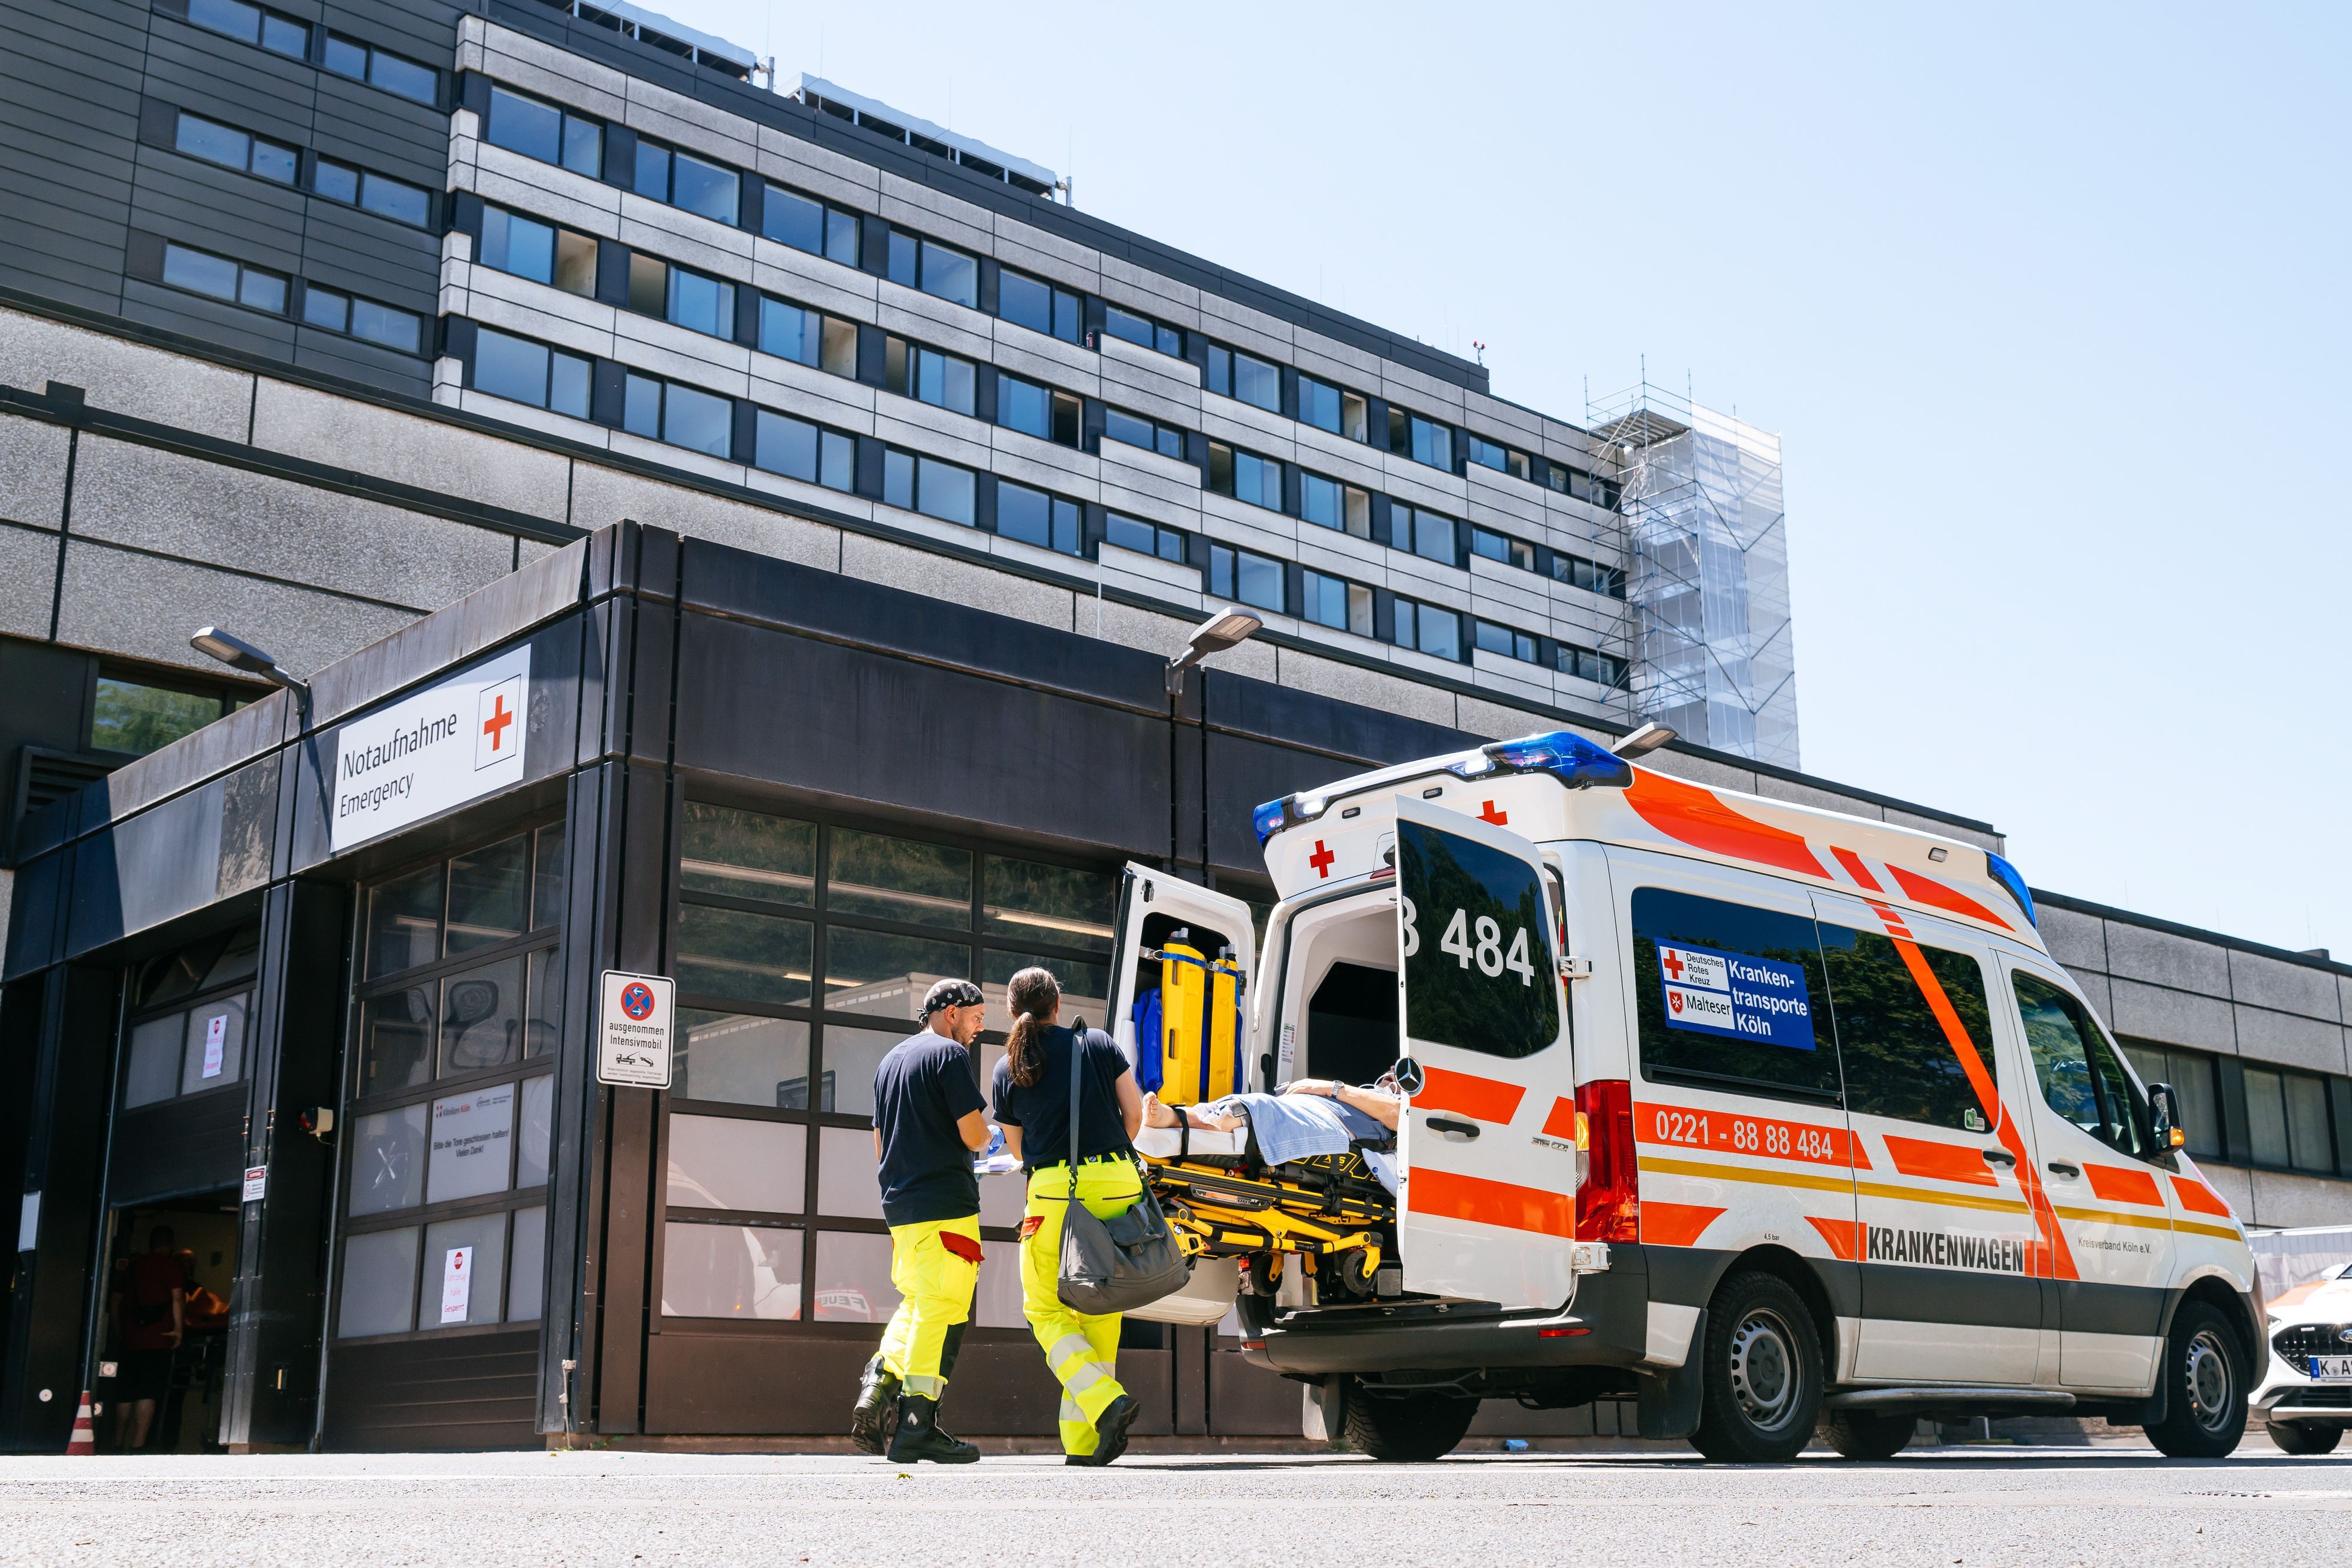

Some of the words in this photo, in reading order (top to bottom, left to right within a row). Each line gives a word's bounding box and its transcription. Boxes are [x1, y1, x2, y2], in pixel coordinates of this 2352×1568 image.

[343, 714, 457, 781] Notaufnahme
[340, 773, 414, 818] Emergency
[1441, 908, 1535, 987] 484
[1686, 952, 1723, 968] Deutsches
[1688, 964, 1709, 975] Rotes
[1689, 974, 1710, 985] Kreuz
[1728, 959, 1795, 988] Kranken-
[1686, 994, 1730, 1015] Malteser
[1732, 987, 1808, 1017] transporte
[609, 1022, 664, 1036] ausgenommen
[1736, 1012, 1772, 1036] Köln
[610, 1034, 662, 1049] Intensivmobil
[433, 1141, 443, 1150] Bitte
[463, 1133, 491, 1146] geschlossen
[1656, 1111, 1709, 1145] 0221
[1733, 1121, 1759, 1151] 88
[1766, 1125, 1790, 1155] 88
[1797, 1129, 1833, 1160] 484
[456, 1148, 469, 1157] Vielen
[1869, 1226, 2023, 1272] KRANKENWAGEN
[2078, 1236, 2121, 1251] Kreisverband
[2122, 1242, 2139, 1252] Köln
[2140, 1243, 2151, 1253] e.V.
[2320, 1360, 2330, 1375] K
[2342, 1360, 2352, 1375] A
